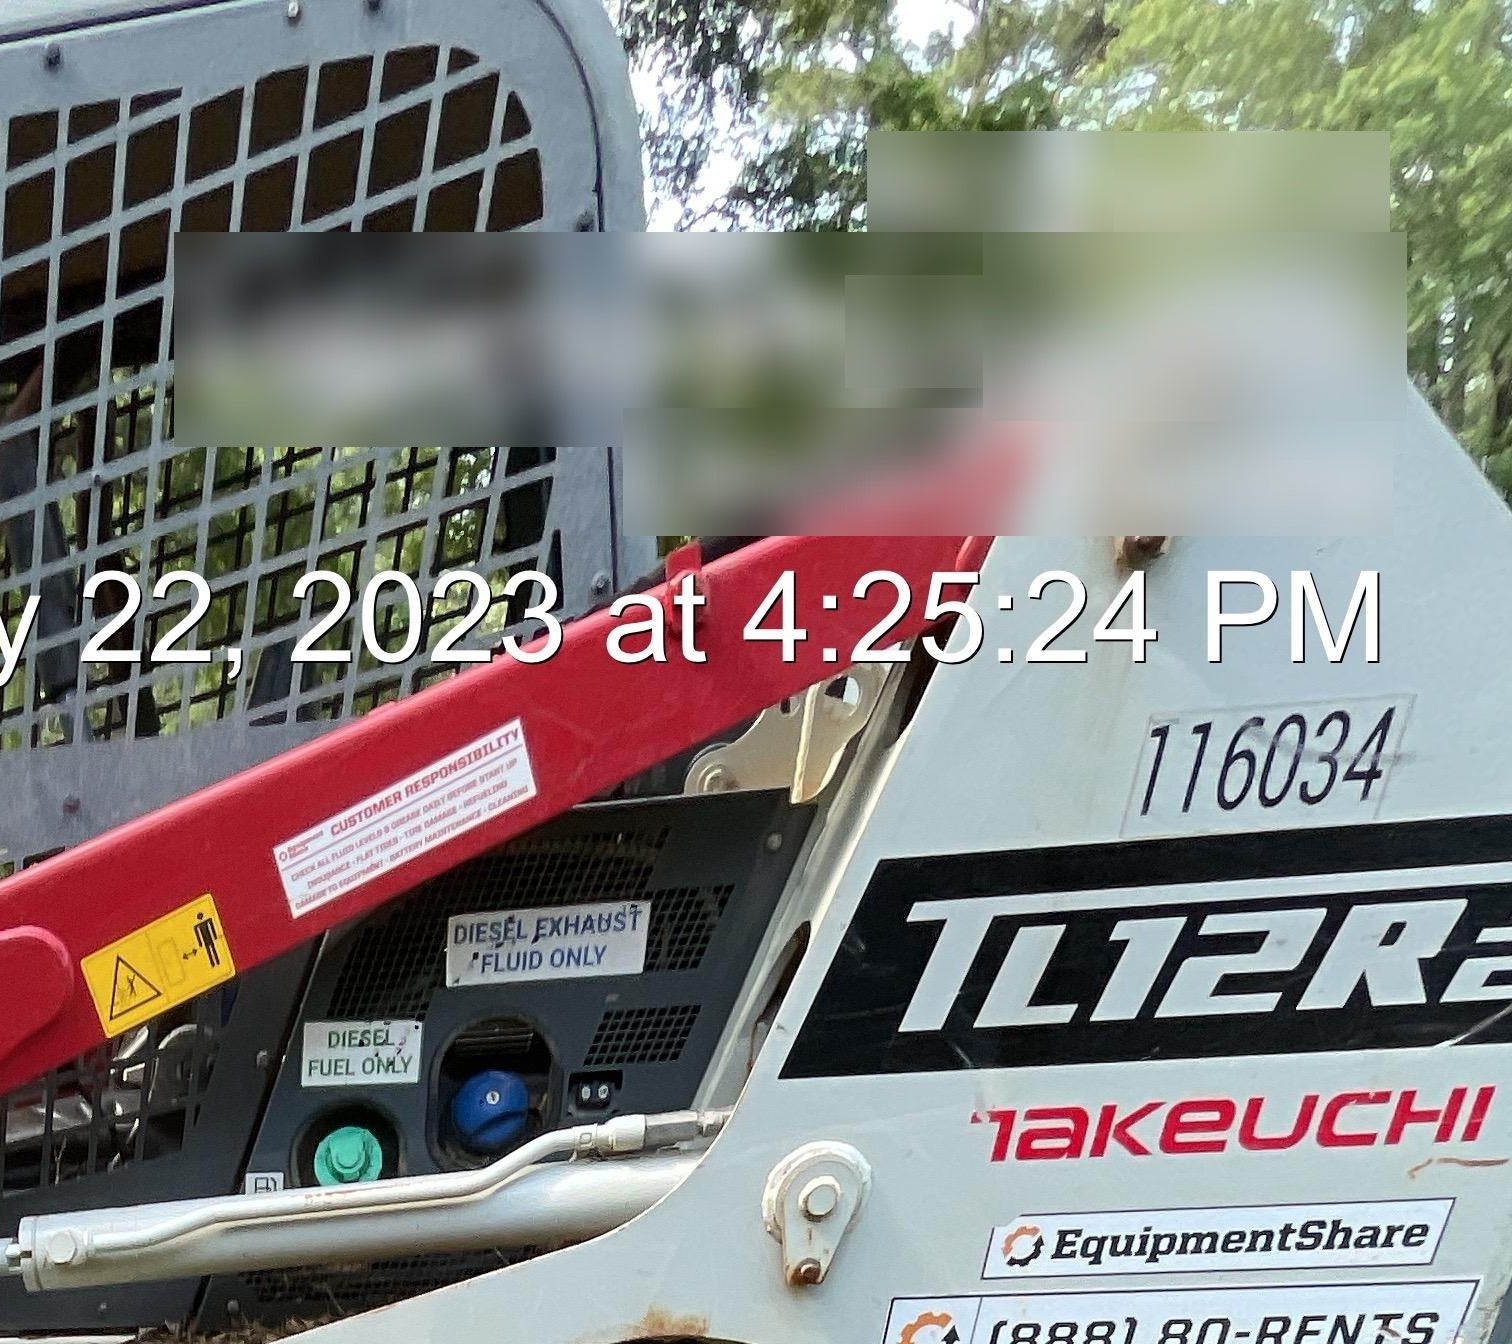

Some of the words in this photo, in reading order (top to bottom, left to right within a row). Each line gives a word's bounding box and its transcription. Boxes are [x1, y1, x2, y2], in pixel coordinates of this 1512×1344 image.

[330, 791, 402, 836] CUSTOMER
[405, 728, 518, 798] RESPONSIBILITY
[1139, 705, 1397, 817] 116034
[454, 918, 528, 946] DIESEL
[535, 903, 642, 940] EXHAUST
[480, 950, 543, 974] FLUID
[550, 944, 608, 968] ONLY
[328, 1029, 395, 1049] DIESEL
[308, 1058, 356, 1077] FUEL
[361, 1055, 413, 1075] ONLY
[1050, 1217, 1430, 1266] EquipmentShare
